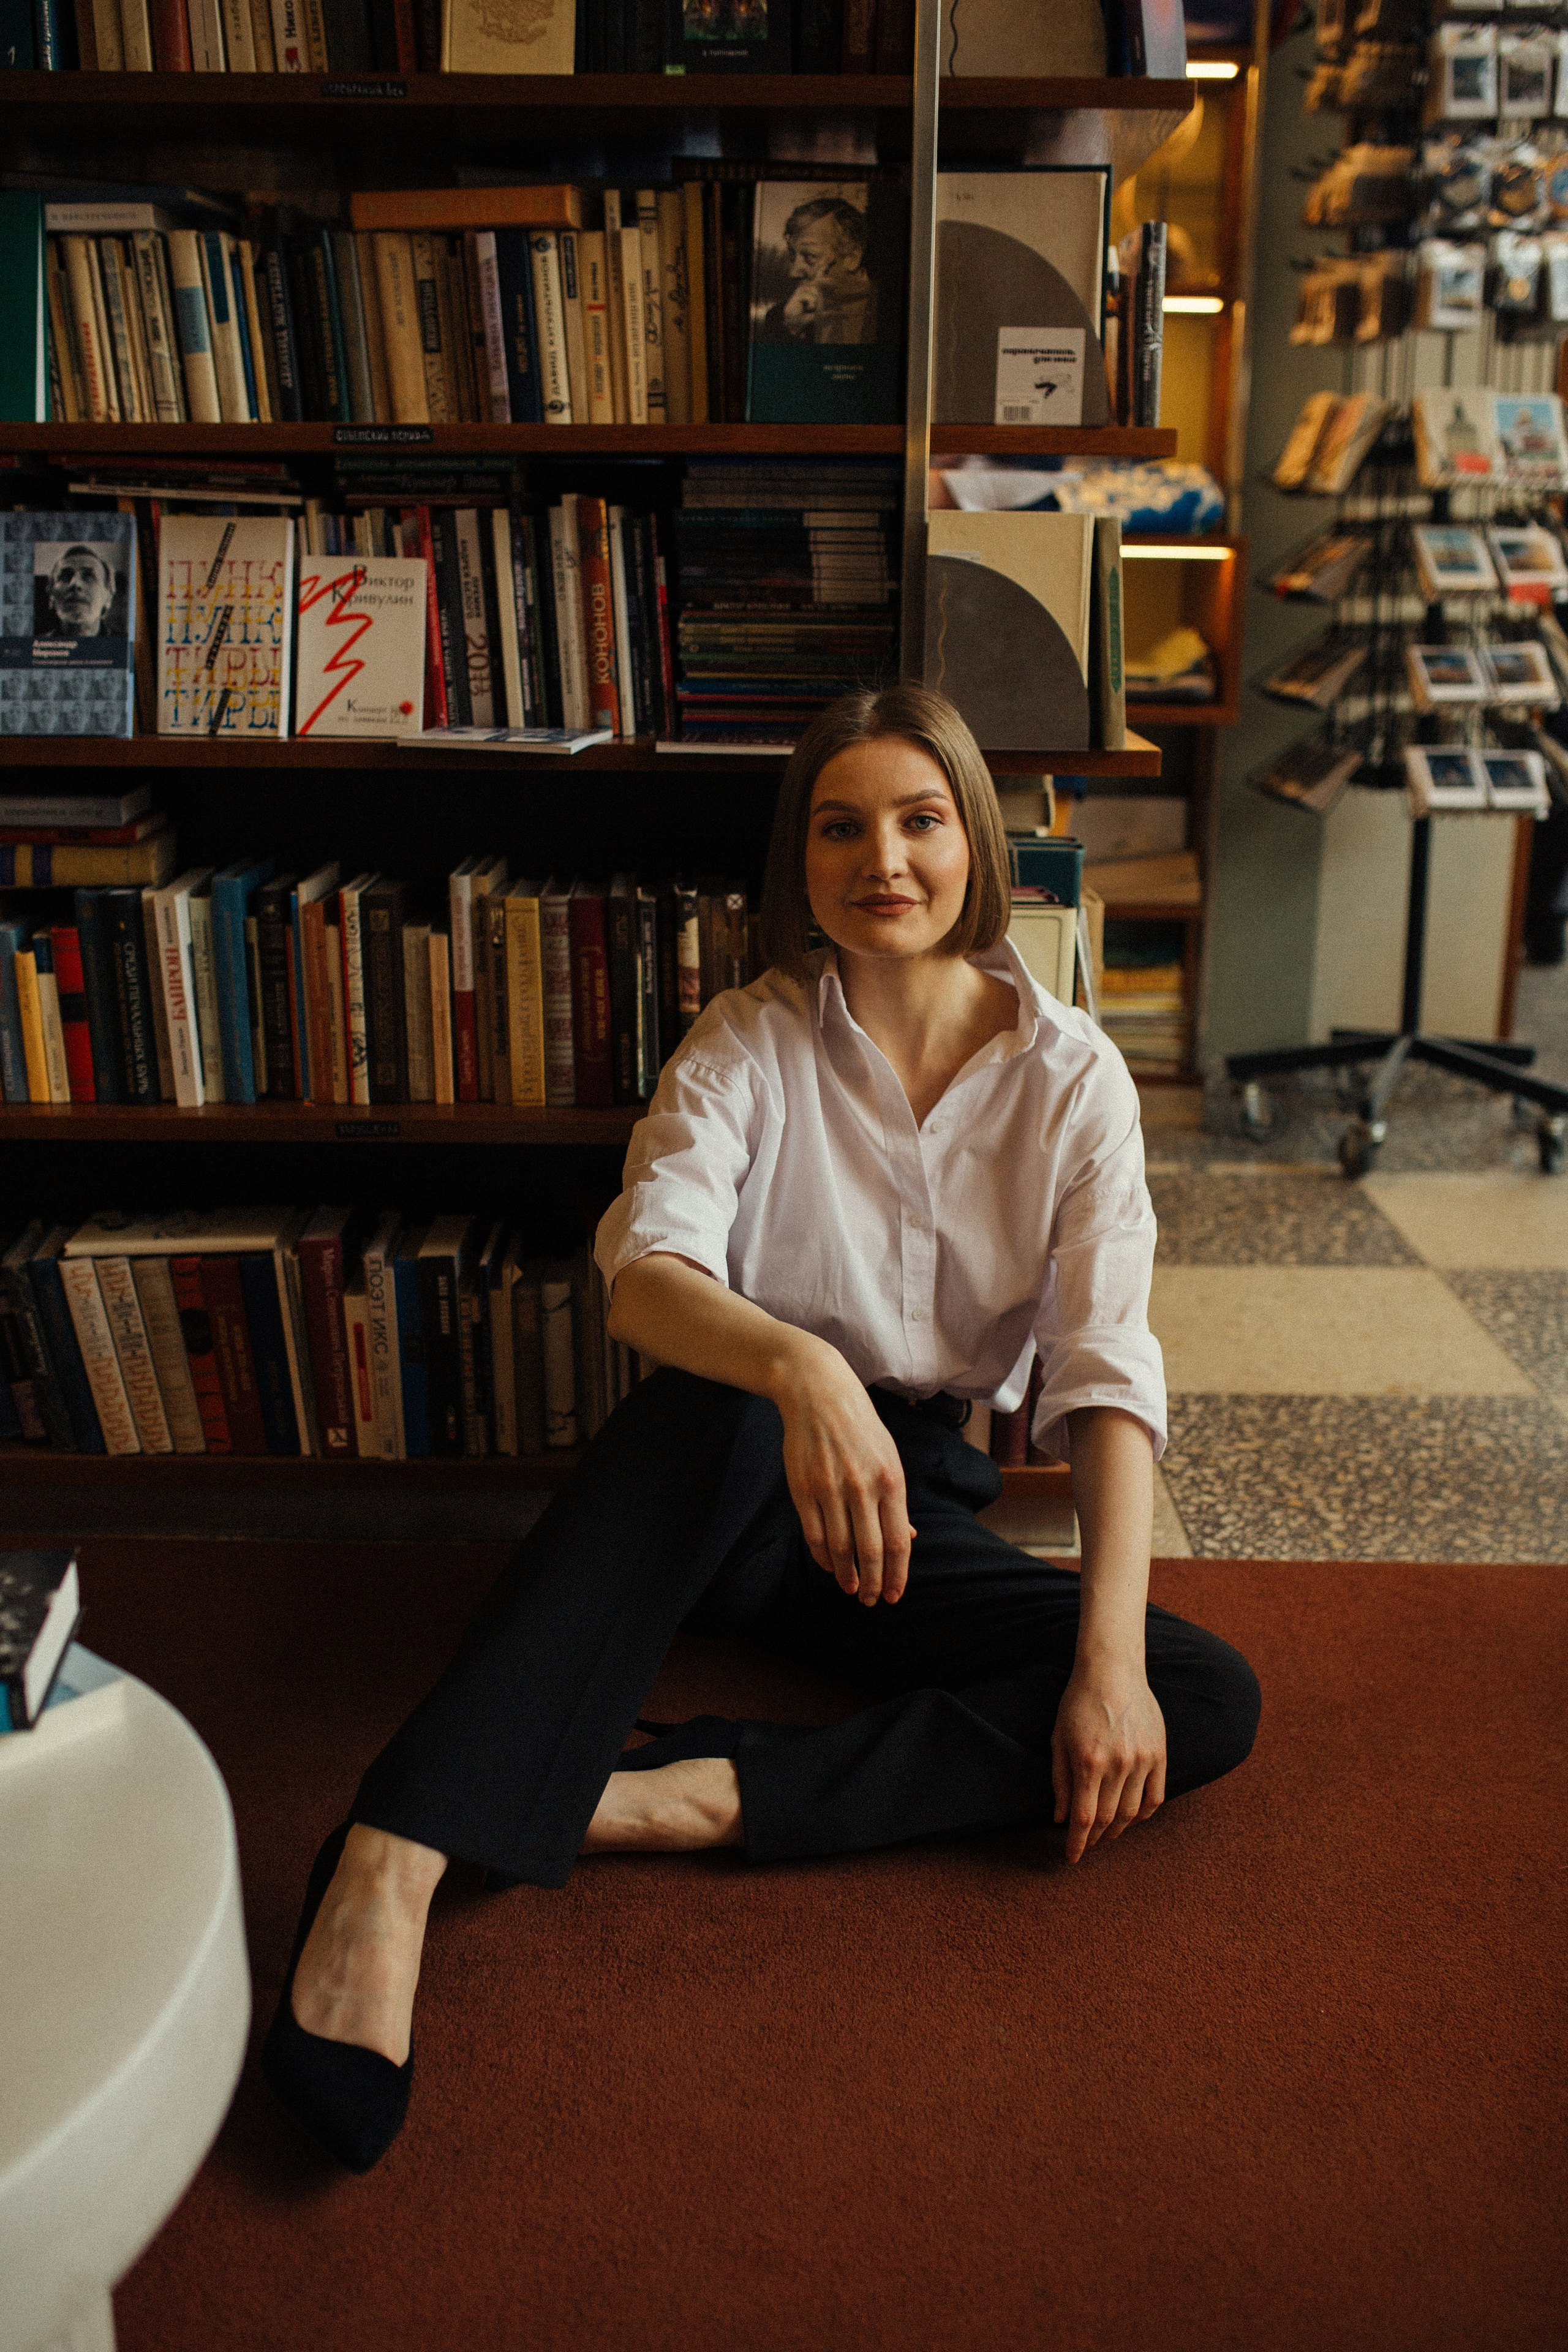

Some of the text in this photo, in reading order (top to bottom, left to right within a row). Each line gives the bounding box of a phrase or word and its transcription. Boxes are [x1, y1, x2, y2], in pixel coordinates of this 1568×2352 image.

[548, 350, 559, 396] ДАВИД
[353, 564, 414, 591] Виктор
[460, 539, 471, 578] АНДРЕЯ
[332, 581, 414, 607] Кривулин
[472, 576, 483, 618] ПРЕМИЯ
[591, 583, 609, 685] КОНОНОВ
[122, 941, 138, 983] СРЕДИ
[165, 947, 186, 1021] БАЙРОН
[127, 984, 146, 1061] ПЕЧАЛЬНЫХ
[135, 1063, 149, 1094] БУРЬ
[368, 1259, 388, 1354] ПОЭТ ИКС
